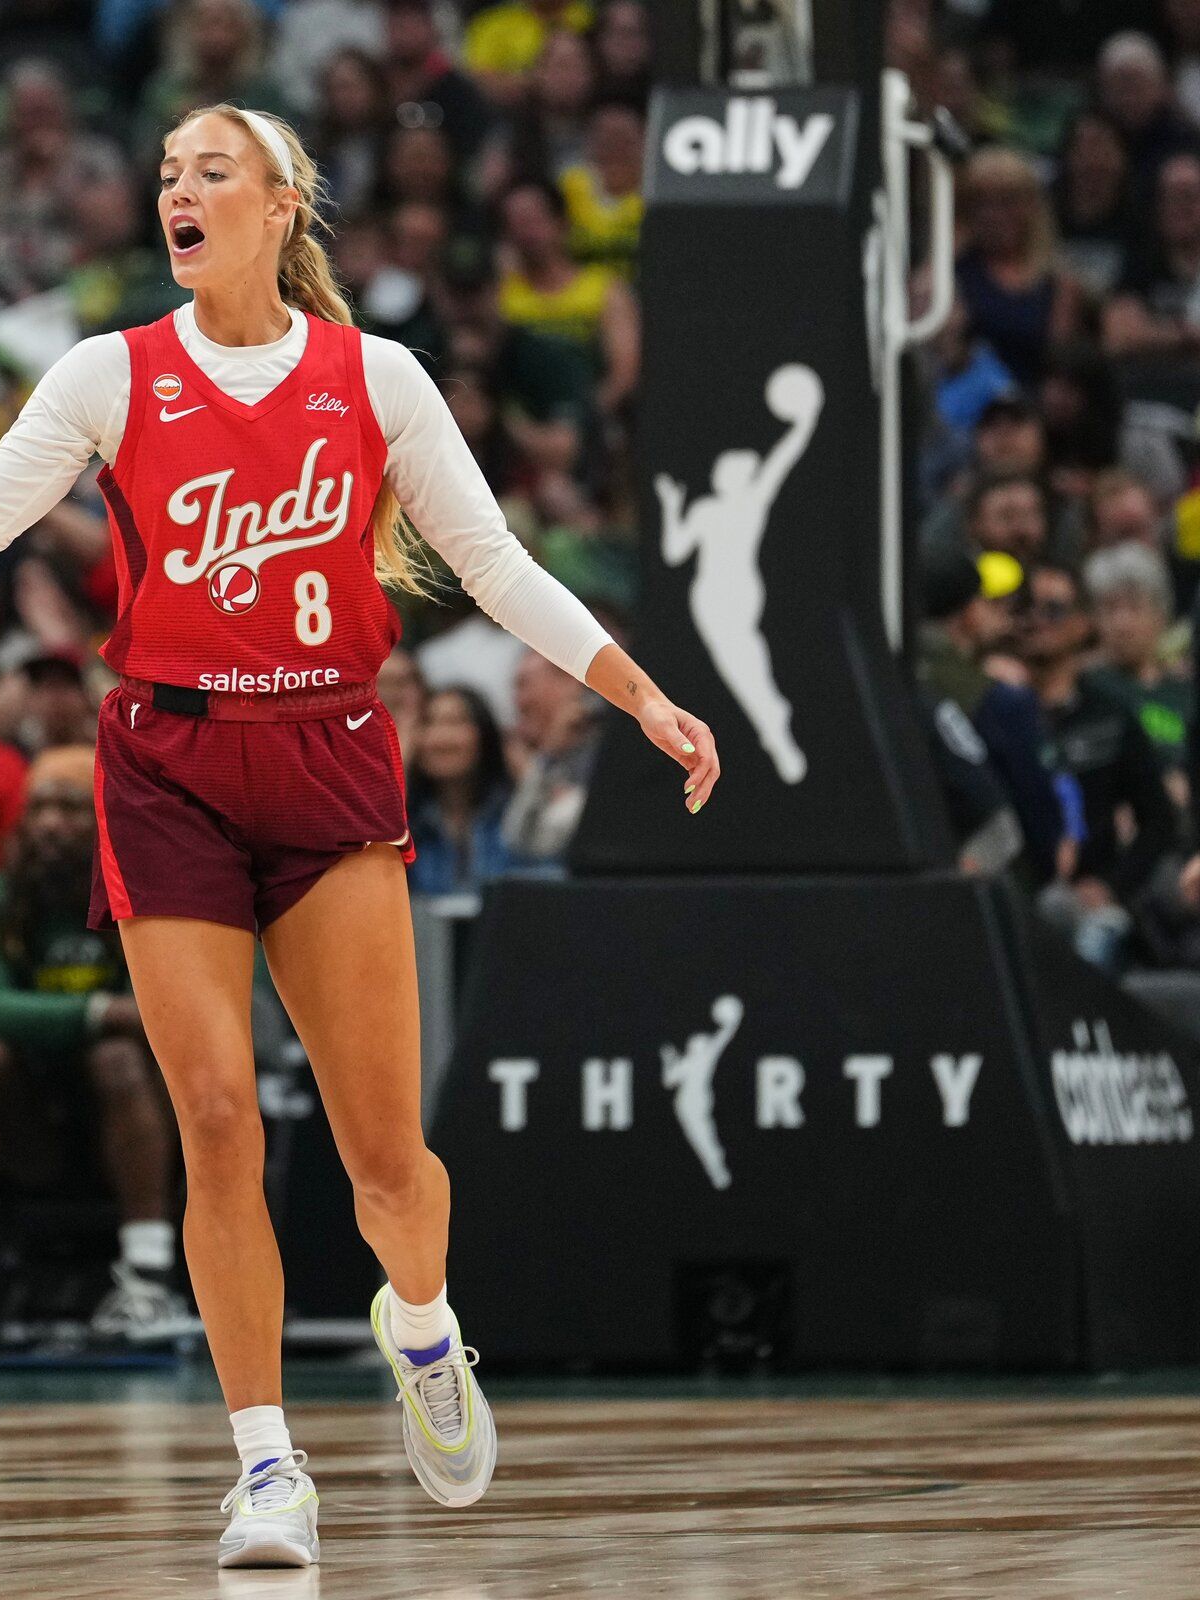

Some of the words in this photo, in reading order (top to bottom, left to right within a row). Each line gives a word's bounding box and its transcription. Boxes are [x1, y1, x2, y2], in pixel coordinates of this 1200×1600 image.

[663, 96, 834, 189] ally
[305, 392, 350, 418] Lilly
[164, 437, 354, 586] Indy
[294, 570, 332, 646] 8
[197, 666, 340, 693] salesforce
